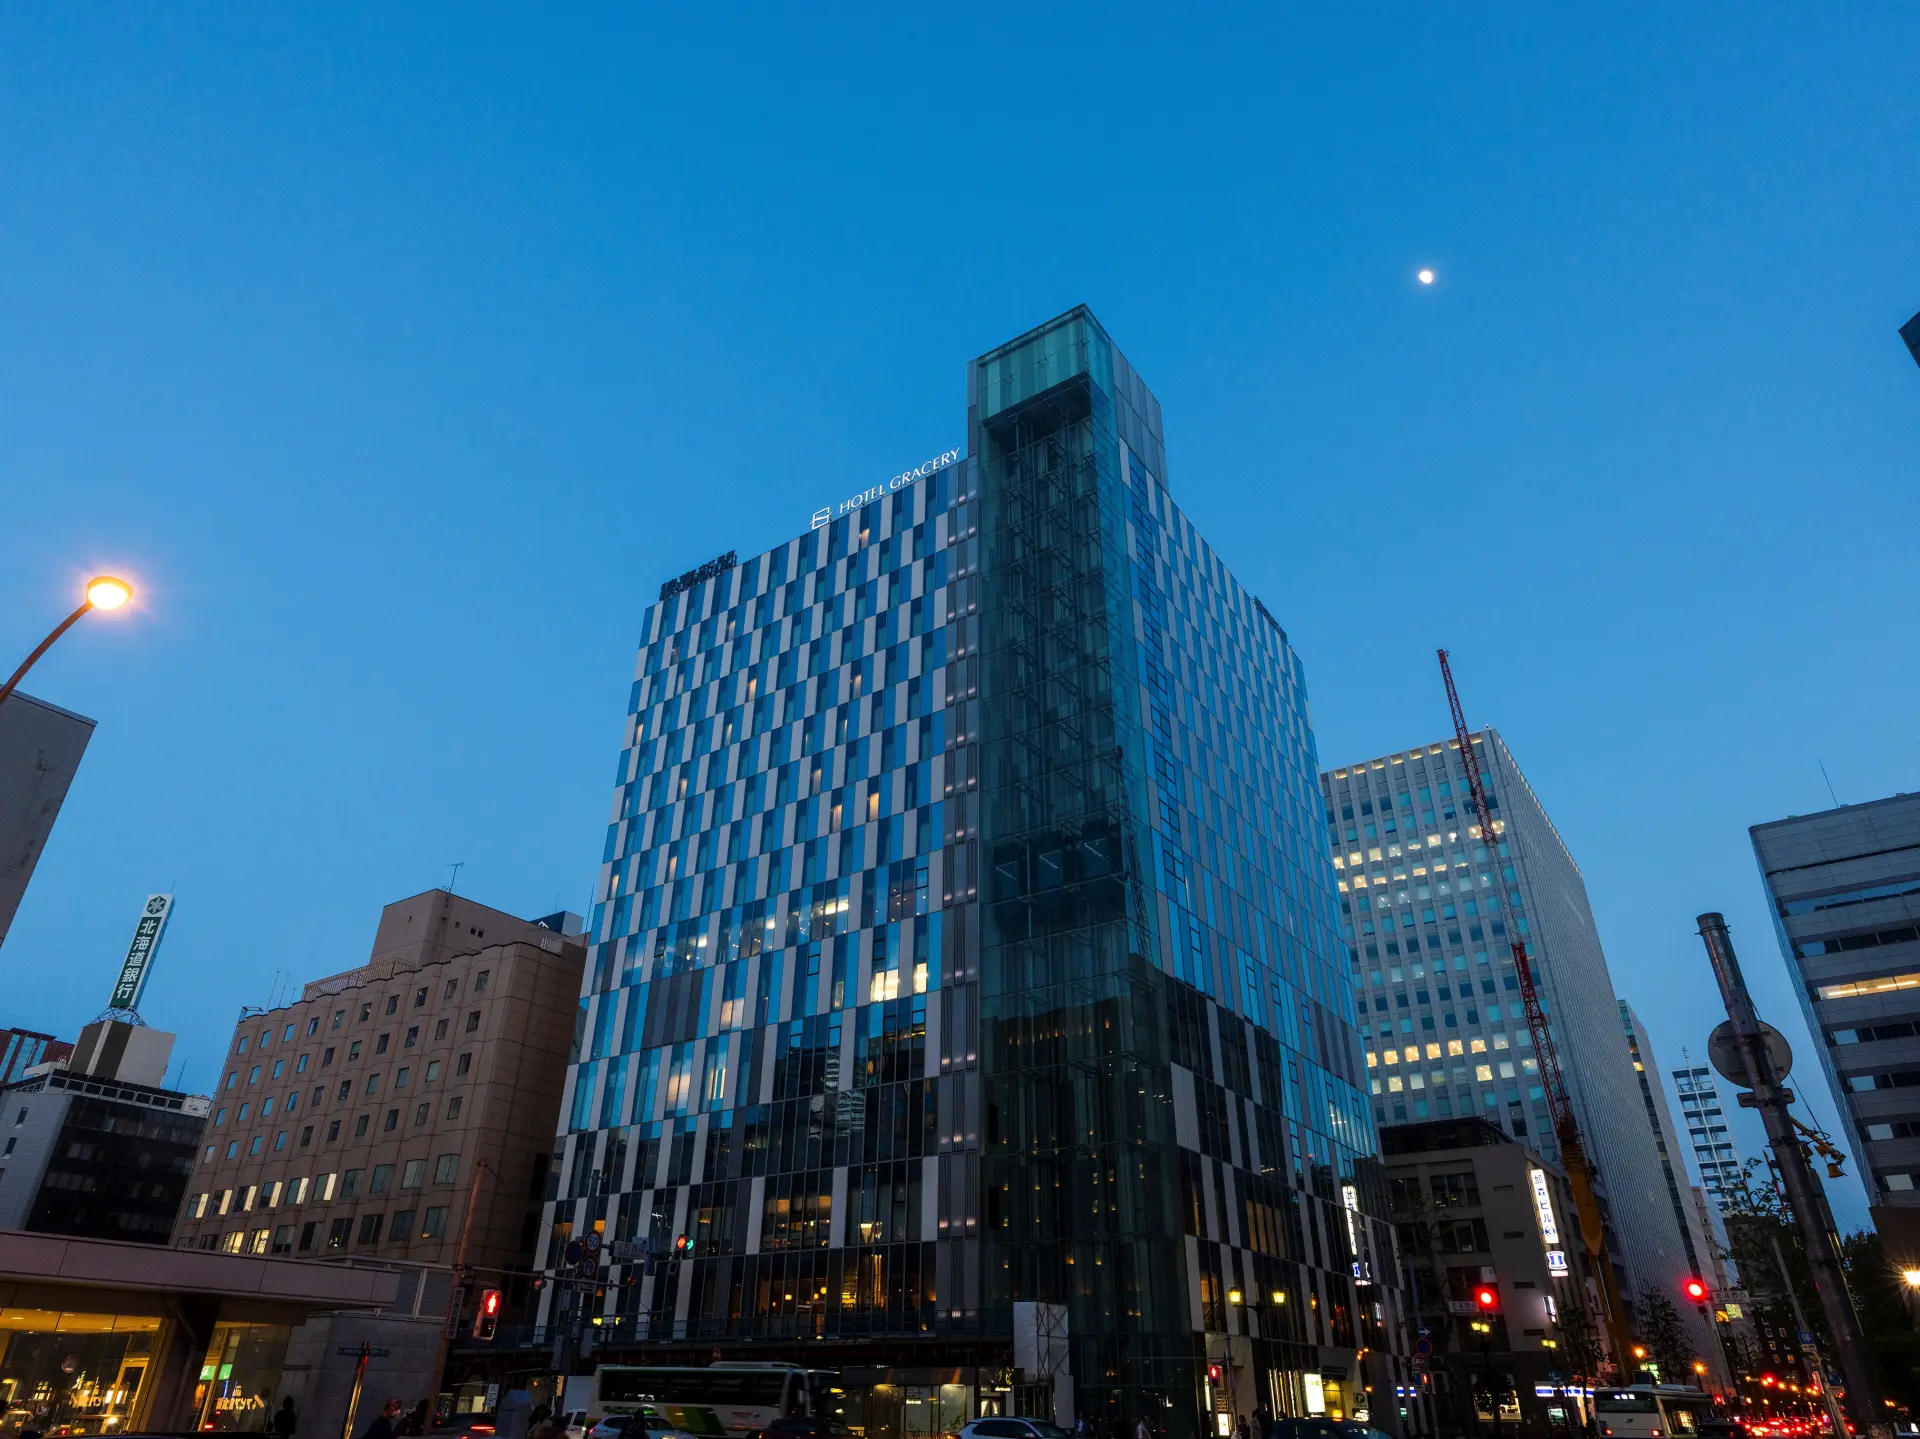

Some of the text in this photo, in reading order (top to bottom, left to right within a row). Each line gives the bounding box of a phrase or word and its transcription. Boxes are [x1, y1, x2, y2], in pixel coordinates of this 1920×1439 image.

[840, 447, 960, 514] HOTEL GRACERY
[117, 919, 157, 999] 北海道銀行
